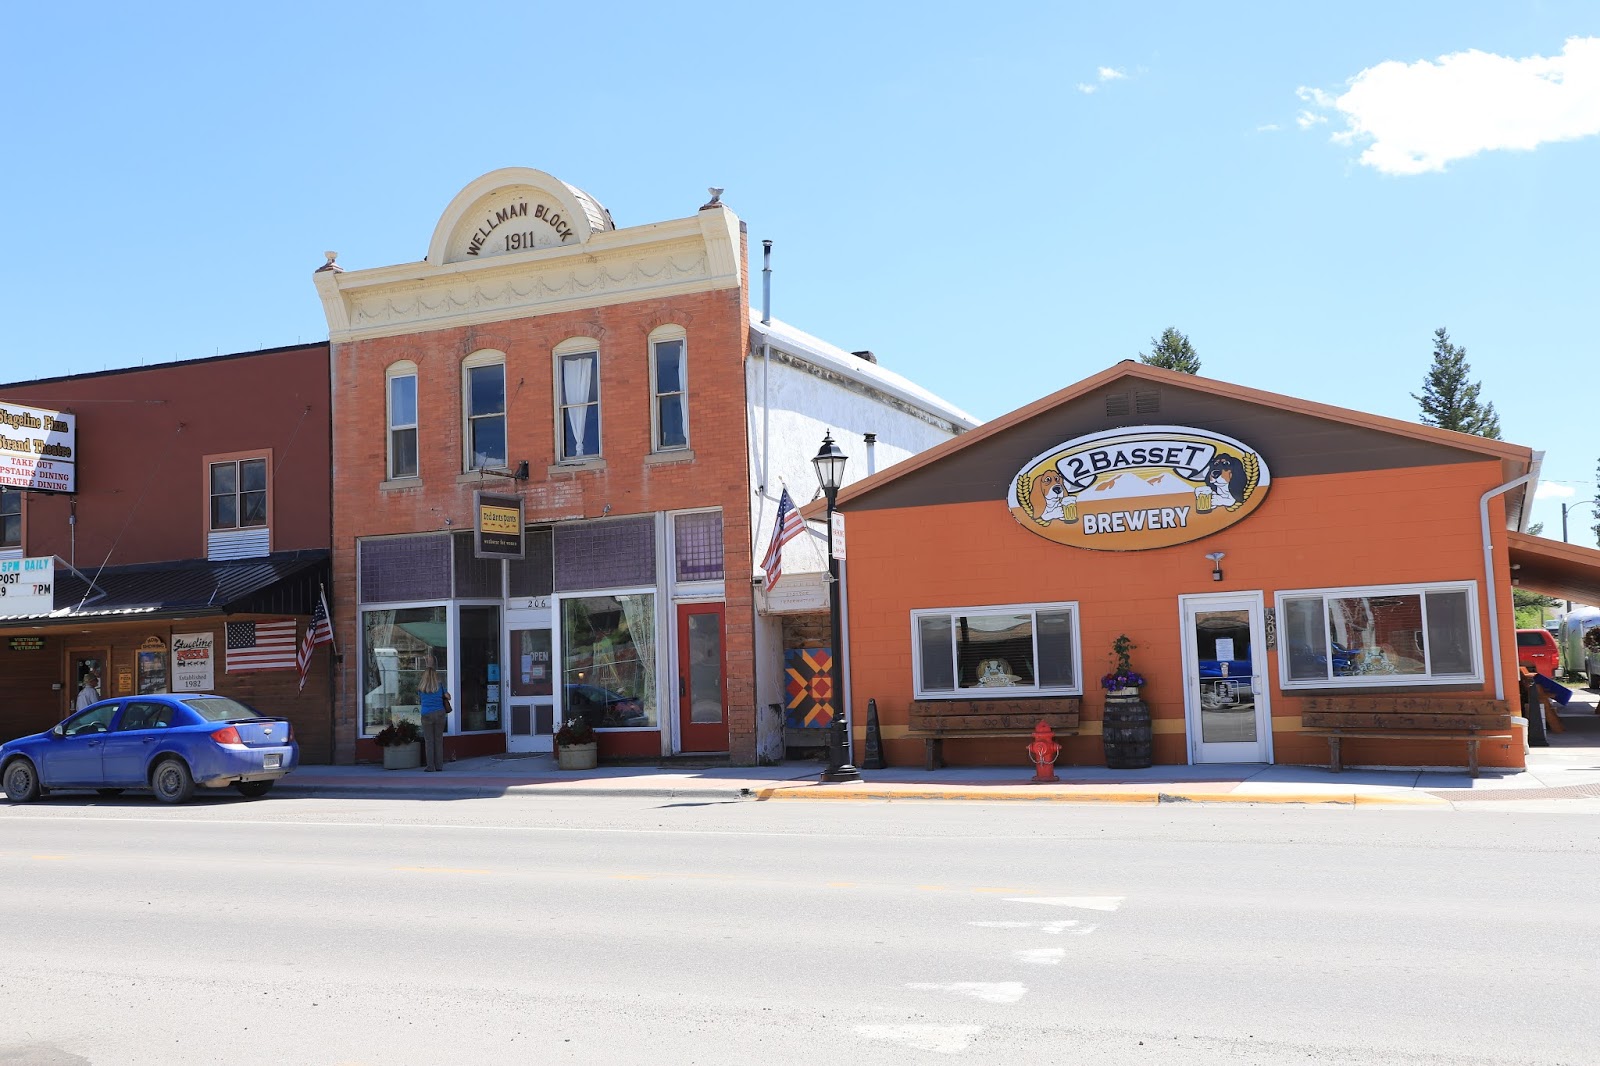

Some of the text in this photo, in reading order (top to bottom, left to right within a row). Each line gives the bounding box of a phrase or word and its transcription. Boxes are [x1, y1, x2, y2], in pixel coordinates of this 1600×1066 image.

[467, 203, 573, 256] WELLMAN BLOCK
[505, 231, 535, 251] 1911
[43, 415, 69, 433] Pizza
[33, 439, 72, 458] Theatre
[11, 457, 54, 470] TAKE OUT
[1067, 457, 1090, 479] 2
[39, 471, 69, 481] DINING
[37, 480, 68, 490] DINING
[1083, 506, 1190, 535] BREWERY
[2, 559, 49, 572] 5PM DAILY
[33, 584, 51, 595] 7PM
[528, 600, 546, 608] 206
[1266, 615, 1275, 645] 202
[173, 637, 212, 652] Stageline
[530, 651, 549, 661] OPEN
[185, 680, 201, 688] 1982
